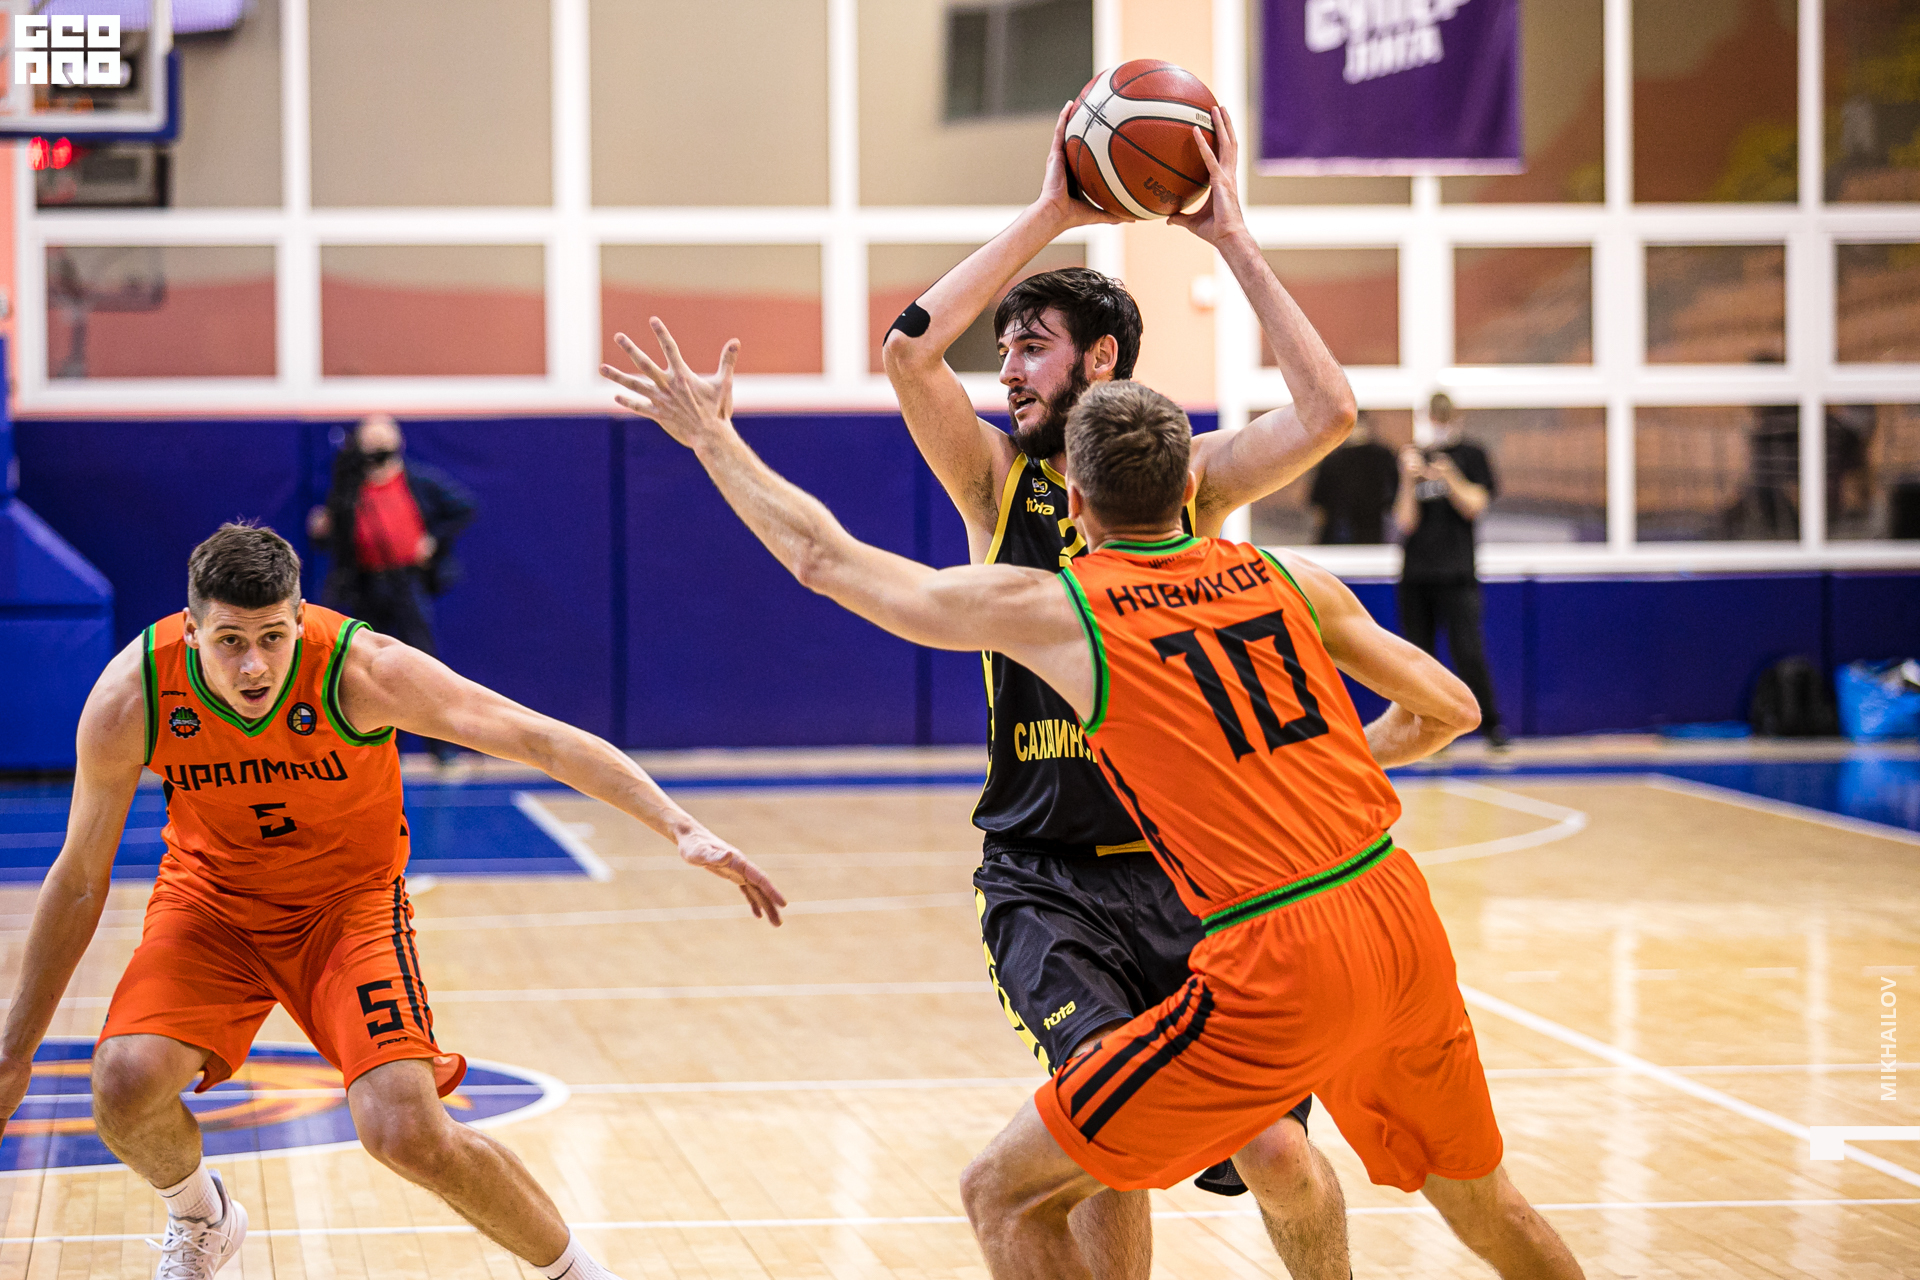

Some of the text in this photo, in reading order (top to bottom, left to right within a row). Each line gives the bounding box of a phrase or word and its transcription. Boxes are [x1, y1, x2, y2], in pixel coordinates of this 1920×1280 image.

[1150, 609, 1329, 762] 10
[165, 750, 349, 791] УРАЛМАШ
[249, 802, 298, 839] 5
[356, 980, 404, 1039] 5
